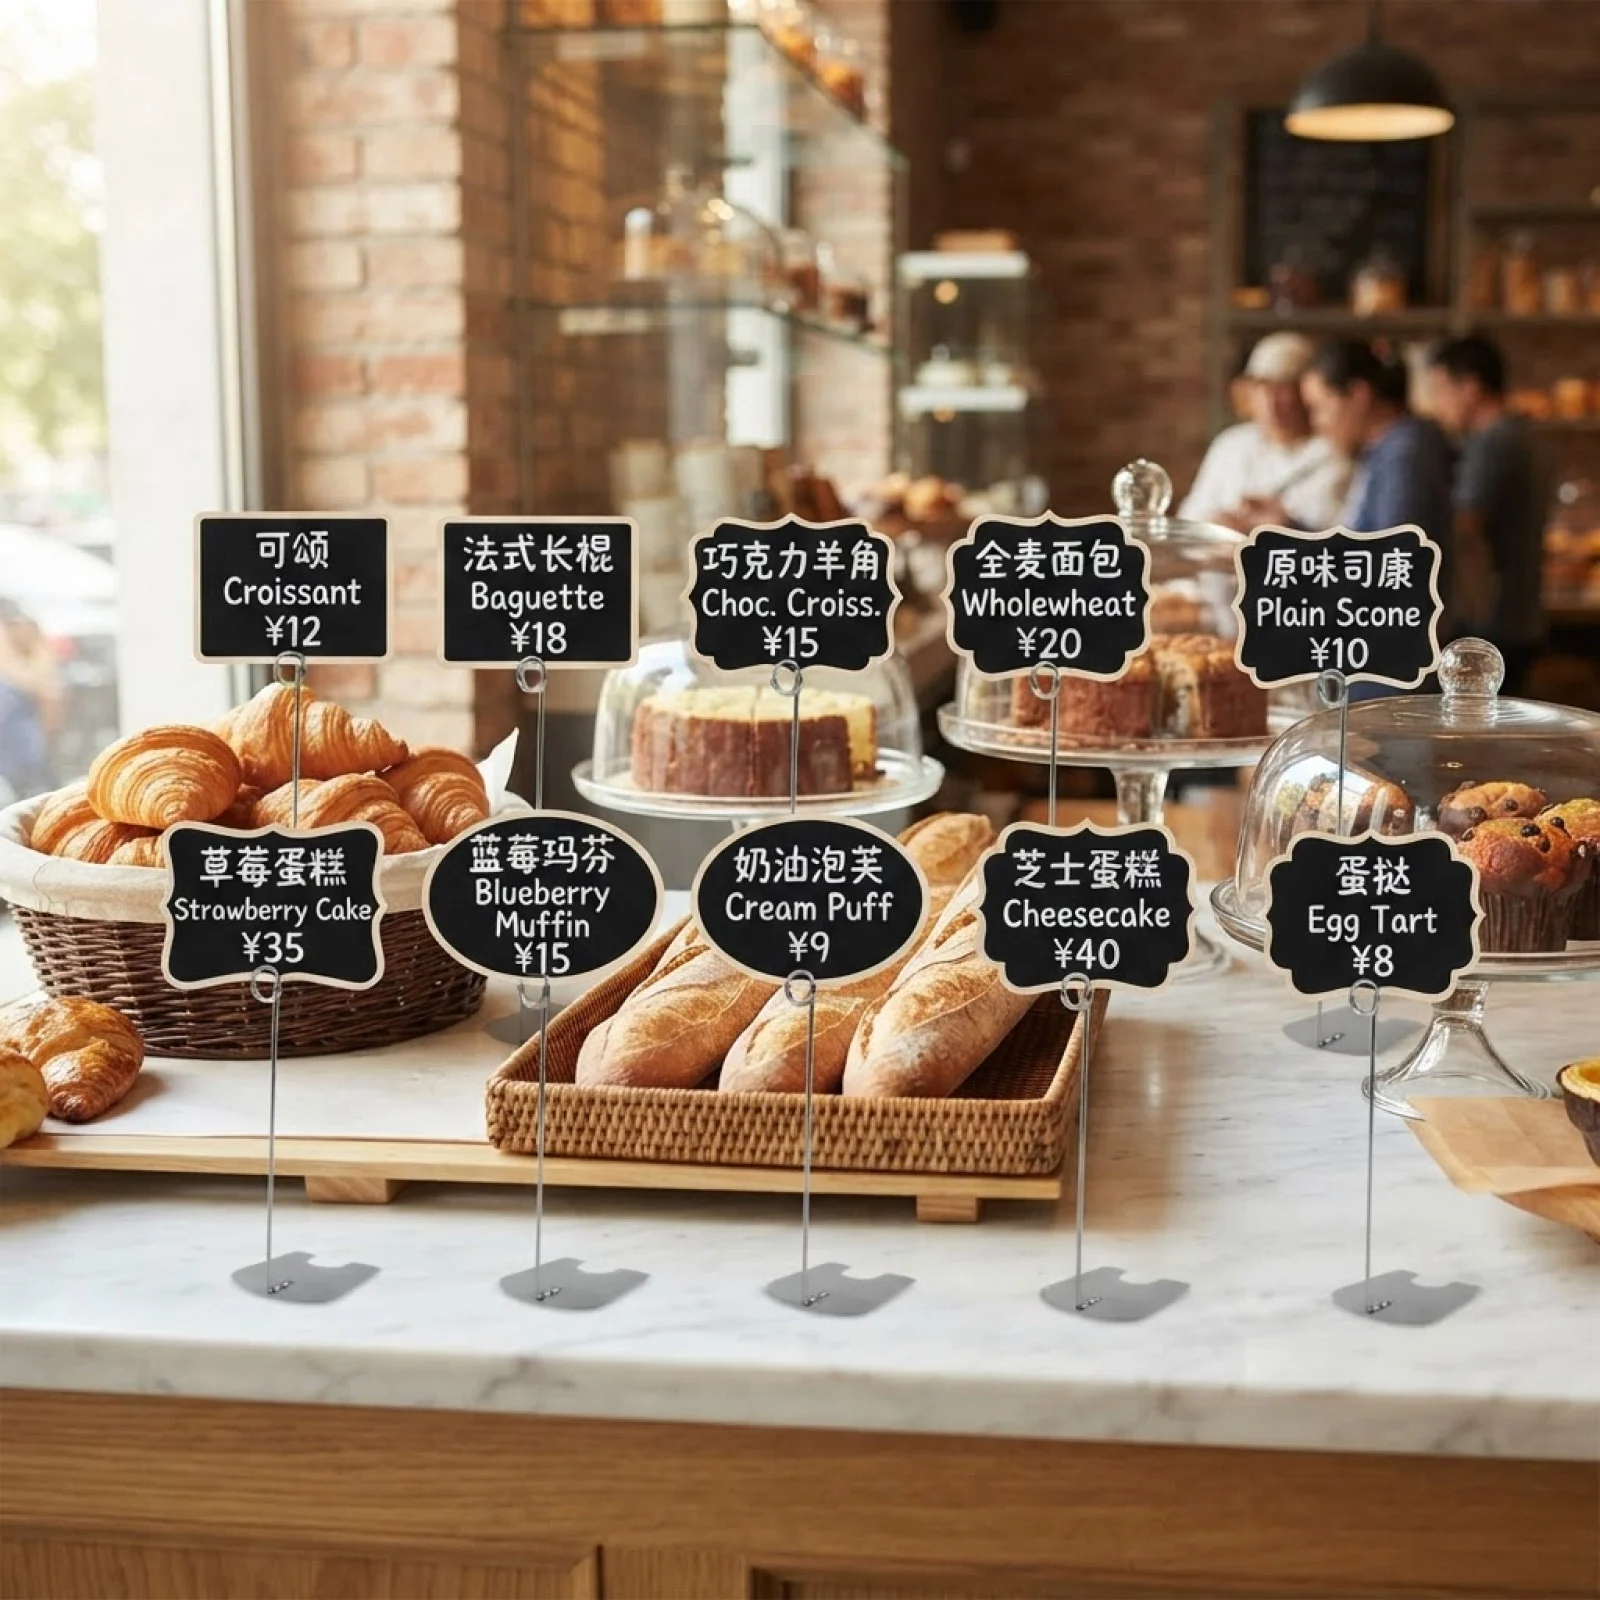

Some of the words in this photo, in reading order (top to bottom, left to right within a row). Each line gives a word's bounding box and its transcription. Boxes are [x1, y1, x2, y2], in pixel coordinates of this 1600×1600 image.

[255, 530, 329, 570] 可颂
[463, 532, 614, 573] 法式长棍
[702, 539, 879, 580] 巧克力羊角
[975, 538, 1122, 579] 全麦面包
[1263, 547, 1414, 590] 原味司康
[223, 575, 362, 606] Croissant
[471, 580, 605, 620] Baguette
[701, 587, 776, 618] Choc.
[786, 587, 881, 618] Croiss.
[961, 587, 1137, 617] Wholewheat
[1256, 596, 1326, 628] Plain
[1336, 596, 1421, 628] Scone
[264, 614, 322, 648] ¥12
[508, 621, 568, 654] ¥18
[761, 624, 820, 659] ¥15
[1016, 626, 1082, 660] ¥20
[1308, 636, 1370, 671] ¥10
[199, 844, 348, 889] 草莓蛋糕
[469, 833, 616, 875] 蓝莓玛芬
[733, 844, 883, 885] 奶油泡芙
[1012, 847, 1162, 890] 芝士蛋糕
[1335, 855, 1412, 896] 蛋挞
[173, 896, 308, 926] Strawberry
[315, 896, 372, 922] Cake
[475, 877, 611, 912] Blueberry
[725, 891, 817, 922] Cream
[827, 891, 895, 922] Puff
[495, 911, 590, 938] Muffin
[1002, 897, 1171, 929] Cheesecake
[1308, 904, 1360, 943] Egg
[1369, 904, 1438, 934] Tart
[241, 930, 304, 964] ¥35
[513, 941, 571, 976] ¥15
[788, 930, 830, 964] ¥9
[1053, 937, 1121, 970] ¥40
[1350, 944, 1395, 978] ¥8
